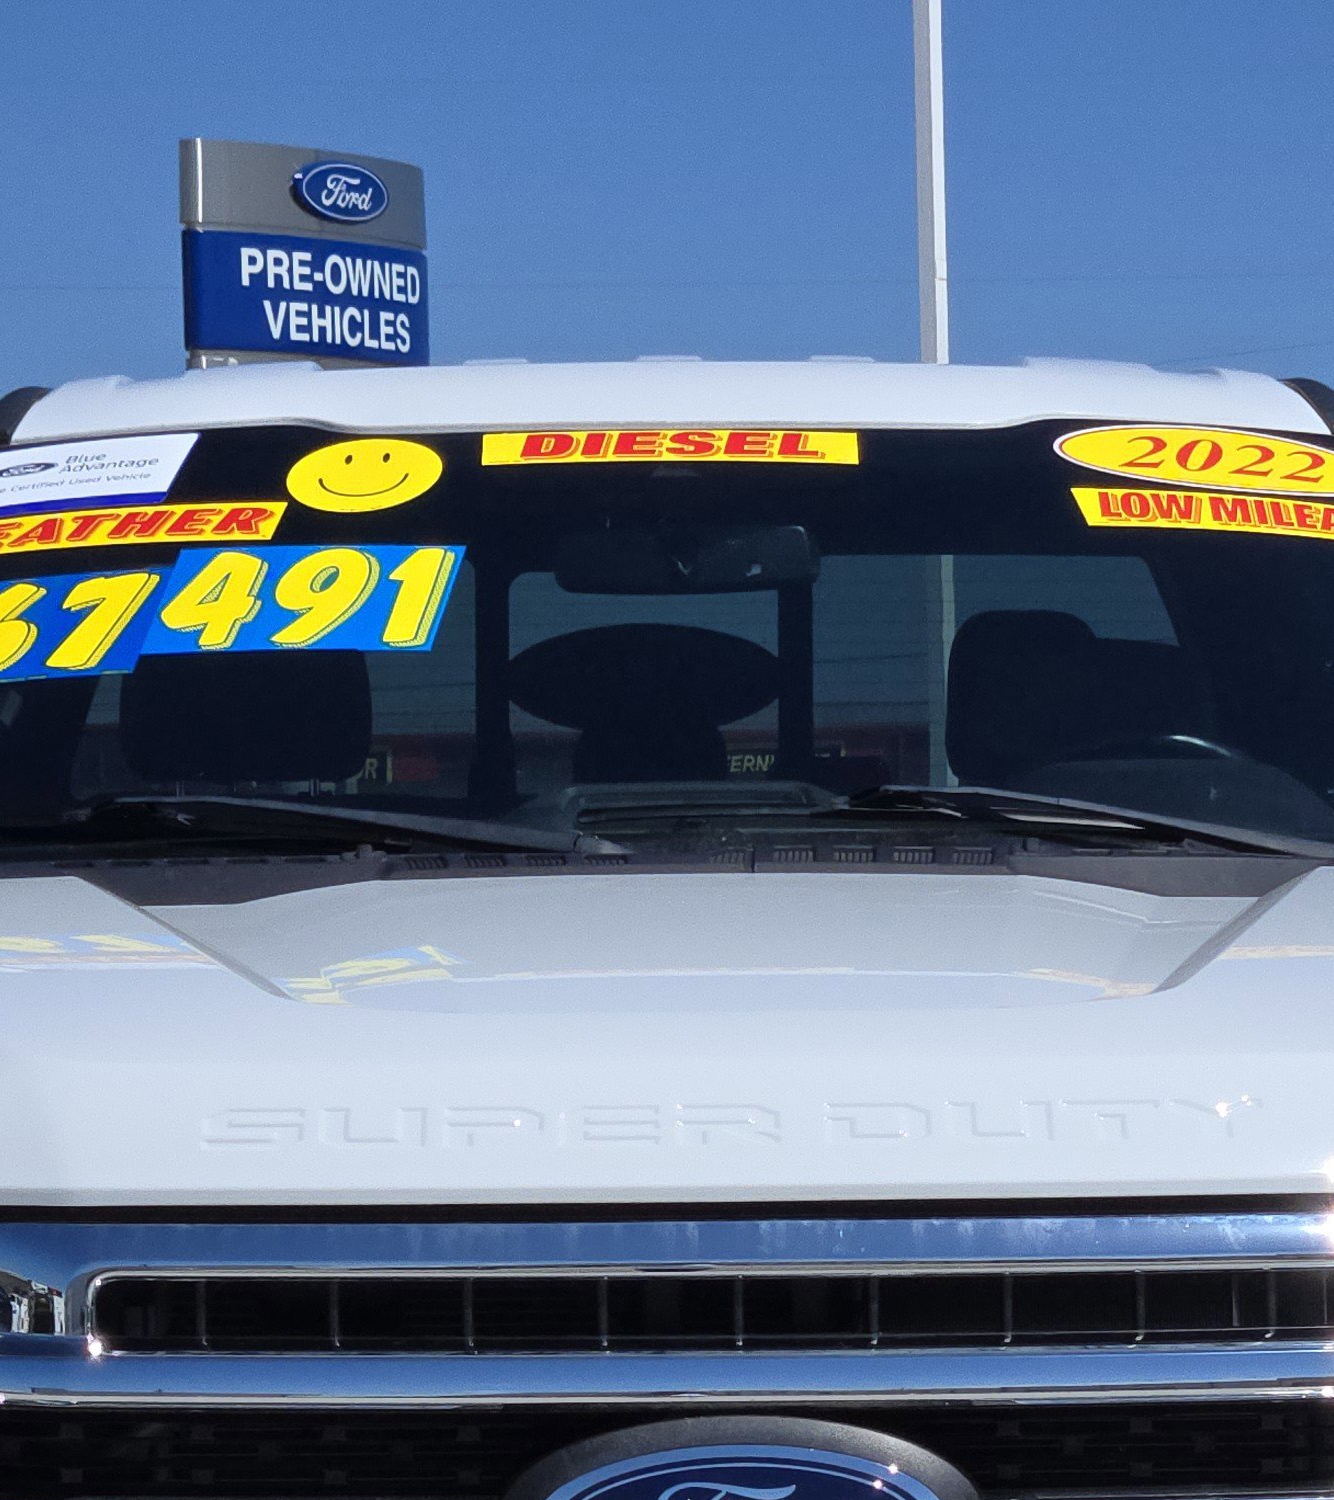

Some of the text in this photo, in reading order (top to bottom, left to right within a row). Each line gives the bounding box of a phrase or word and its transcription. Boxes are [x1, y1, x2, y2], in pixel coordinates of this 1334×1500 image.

[320, 173, 373, 212] Ford
[240, 247, 420, 305] PRE-OWNED
[263, 300, 411, 353] VEHICLES
[58, 457, 160, 474] Advantage
[64, 452, 108, 465] Blue
[520, 432, 825, 460] DIESEL
[1118, 436, 1327, 483] 2022
[1098, 491, 1202, 523] LOW
[200, 1095, 1265, 1151] SUPER DUTY
